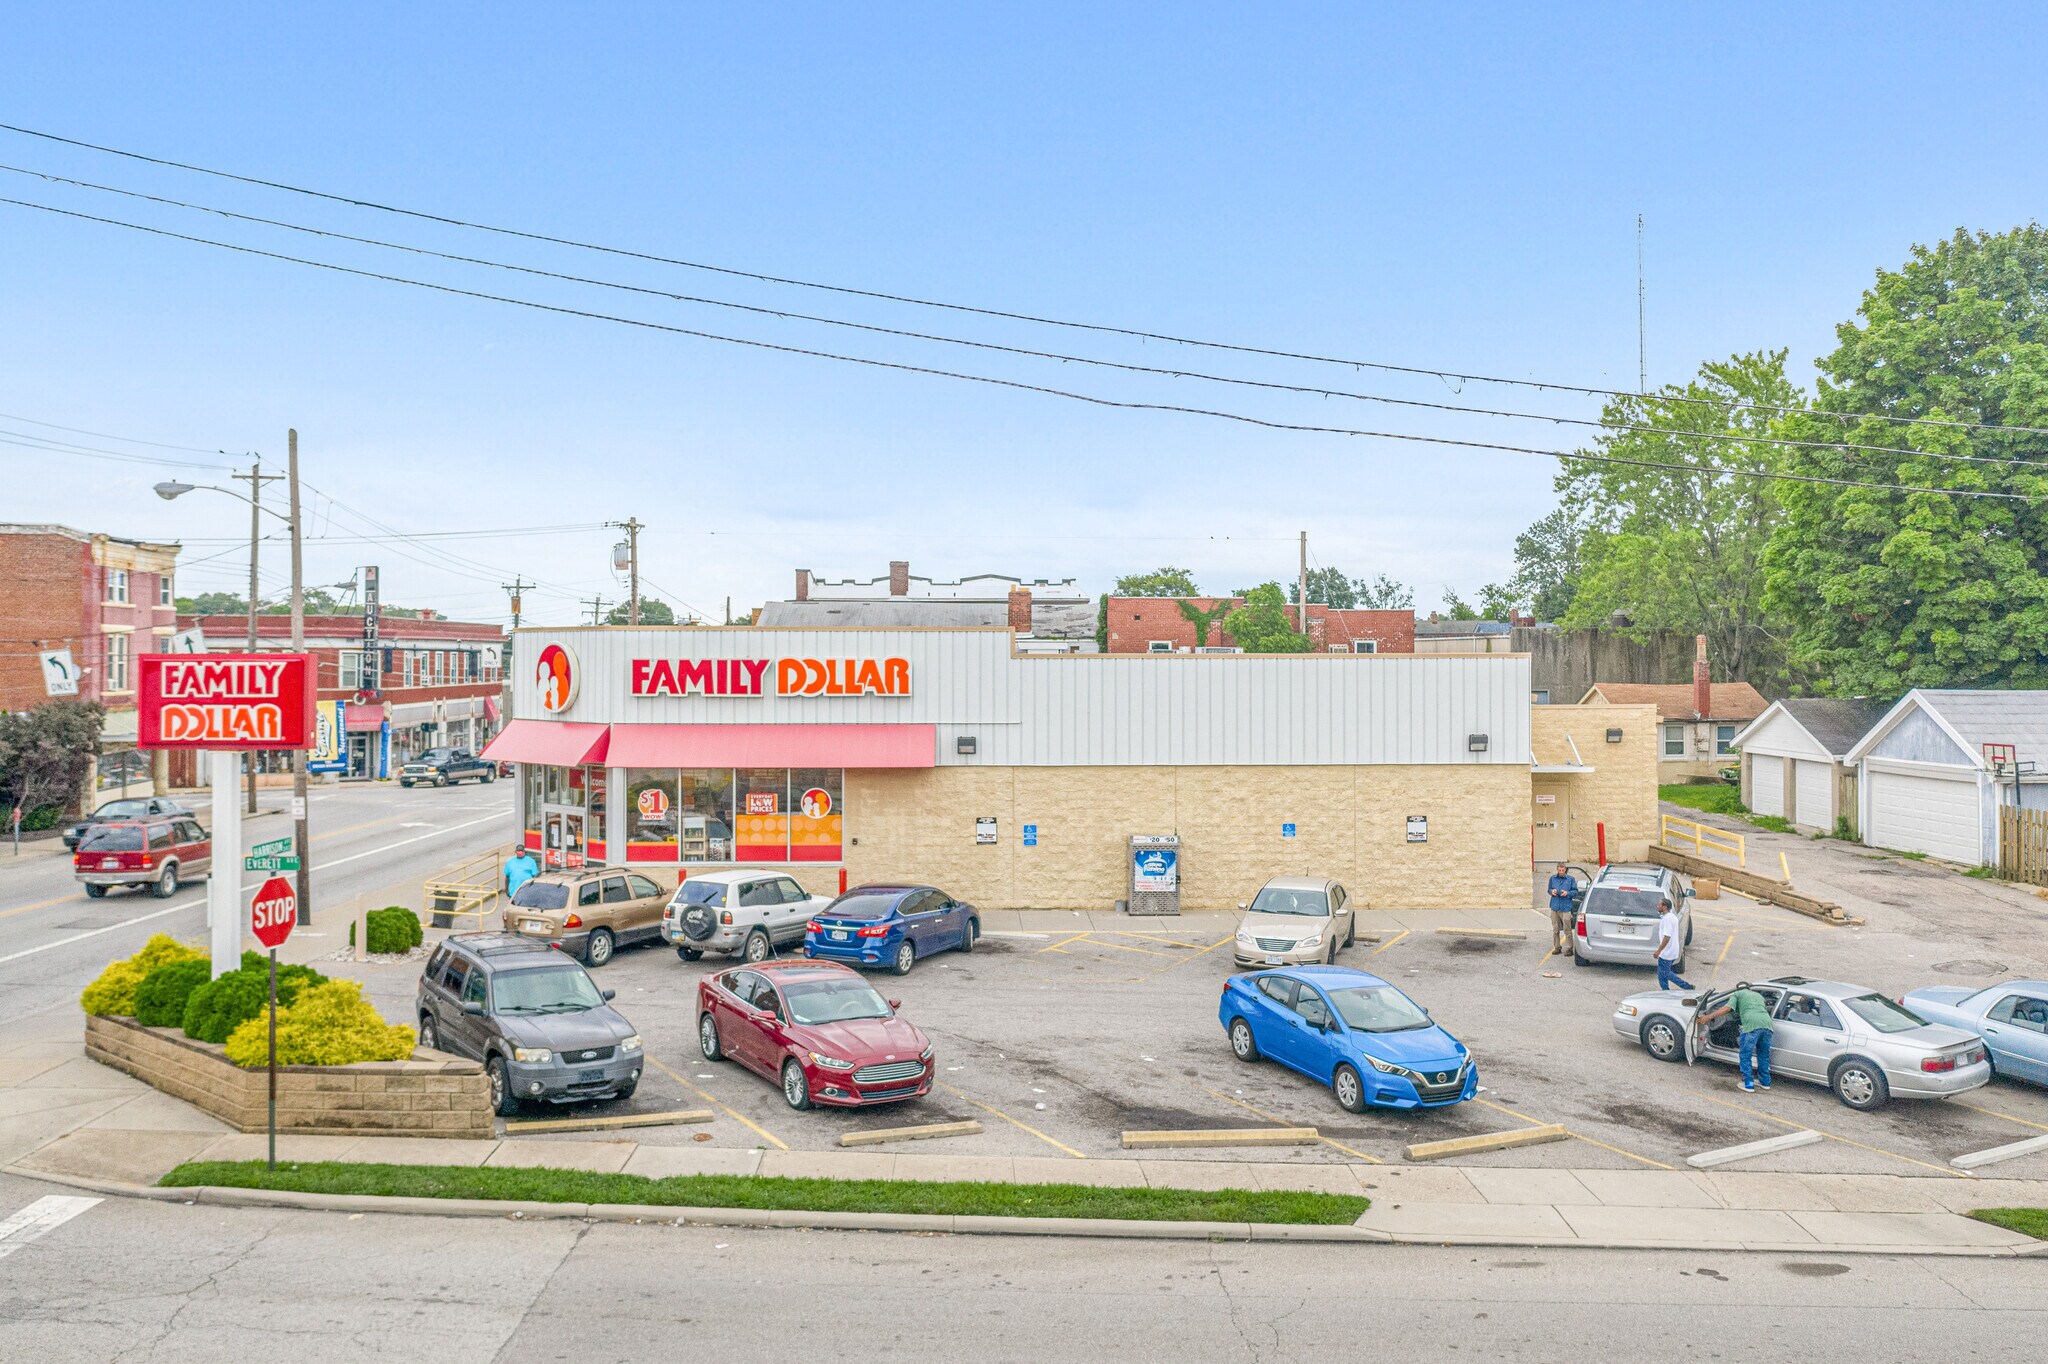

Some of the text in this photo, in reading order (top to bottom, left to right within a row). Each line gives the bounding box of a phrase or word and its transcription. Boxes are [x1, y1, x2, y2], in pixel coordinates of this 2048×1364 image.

[364, 592, 375, 676] AUCTION
[50, 681, 73, 693] ONLY
[162, 663, 285, 697] FAMILY
[631, 657, 910, 695] FAMILY DOLLAR
[162, 704, 281, 740] DOLLAR
[338, 707, 346, 755] Bicentennial
[641, 790, 663, 814] $1
[750, 798, 773, 807] LOW
[247, 857, 281, 869] EVERETT
[253, 841, 283, 858] HARRISON
[254, 896, 294, 929] STOP
